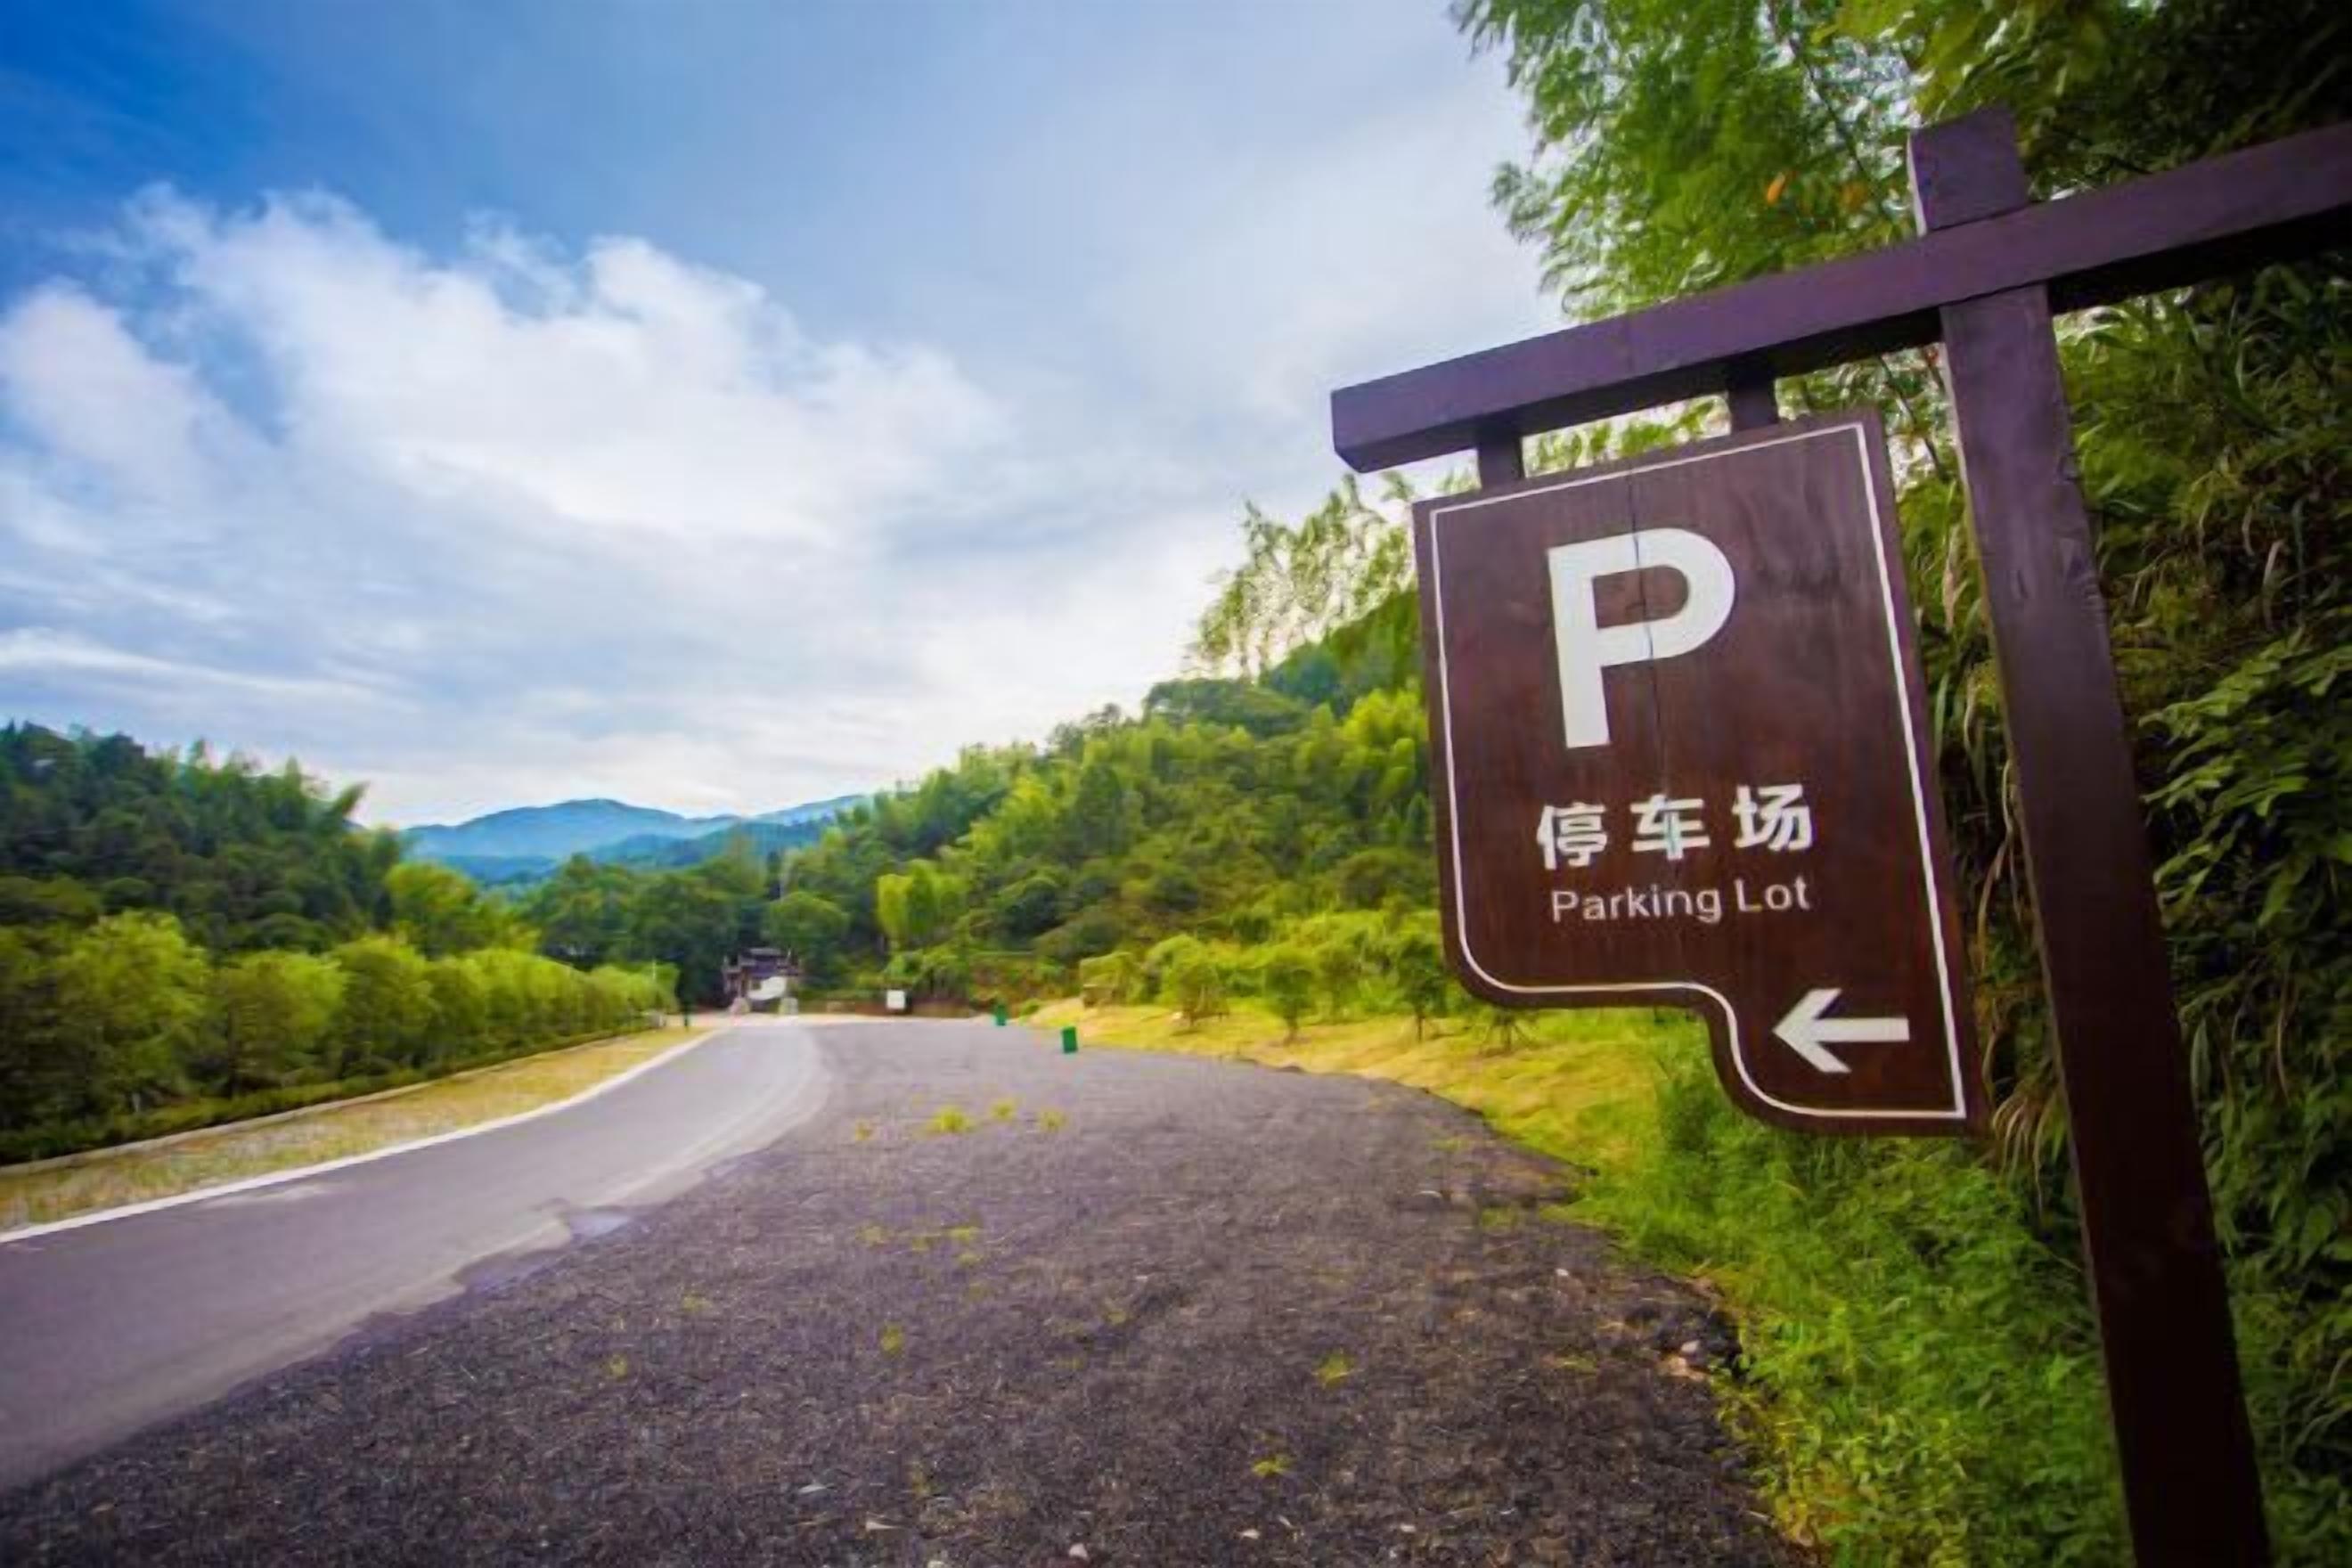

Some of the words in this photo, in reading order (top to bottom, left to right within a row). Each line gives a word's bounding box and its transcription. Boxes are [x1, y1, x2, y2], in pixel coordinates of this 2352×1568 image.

[1548, 527, 1735, 748] P
[1536, 783, 1813, 870] 停车场
[1551, 883, 1721, 923] Parking
[1735, 877, 1810, 912] Lot
